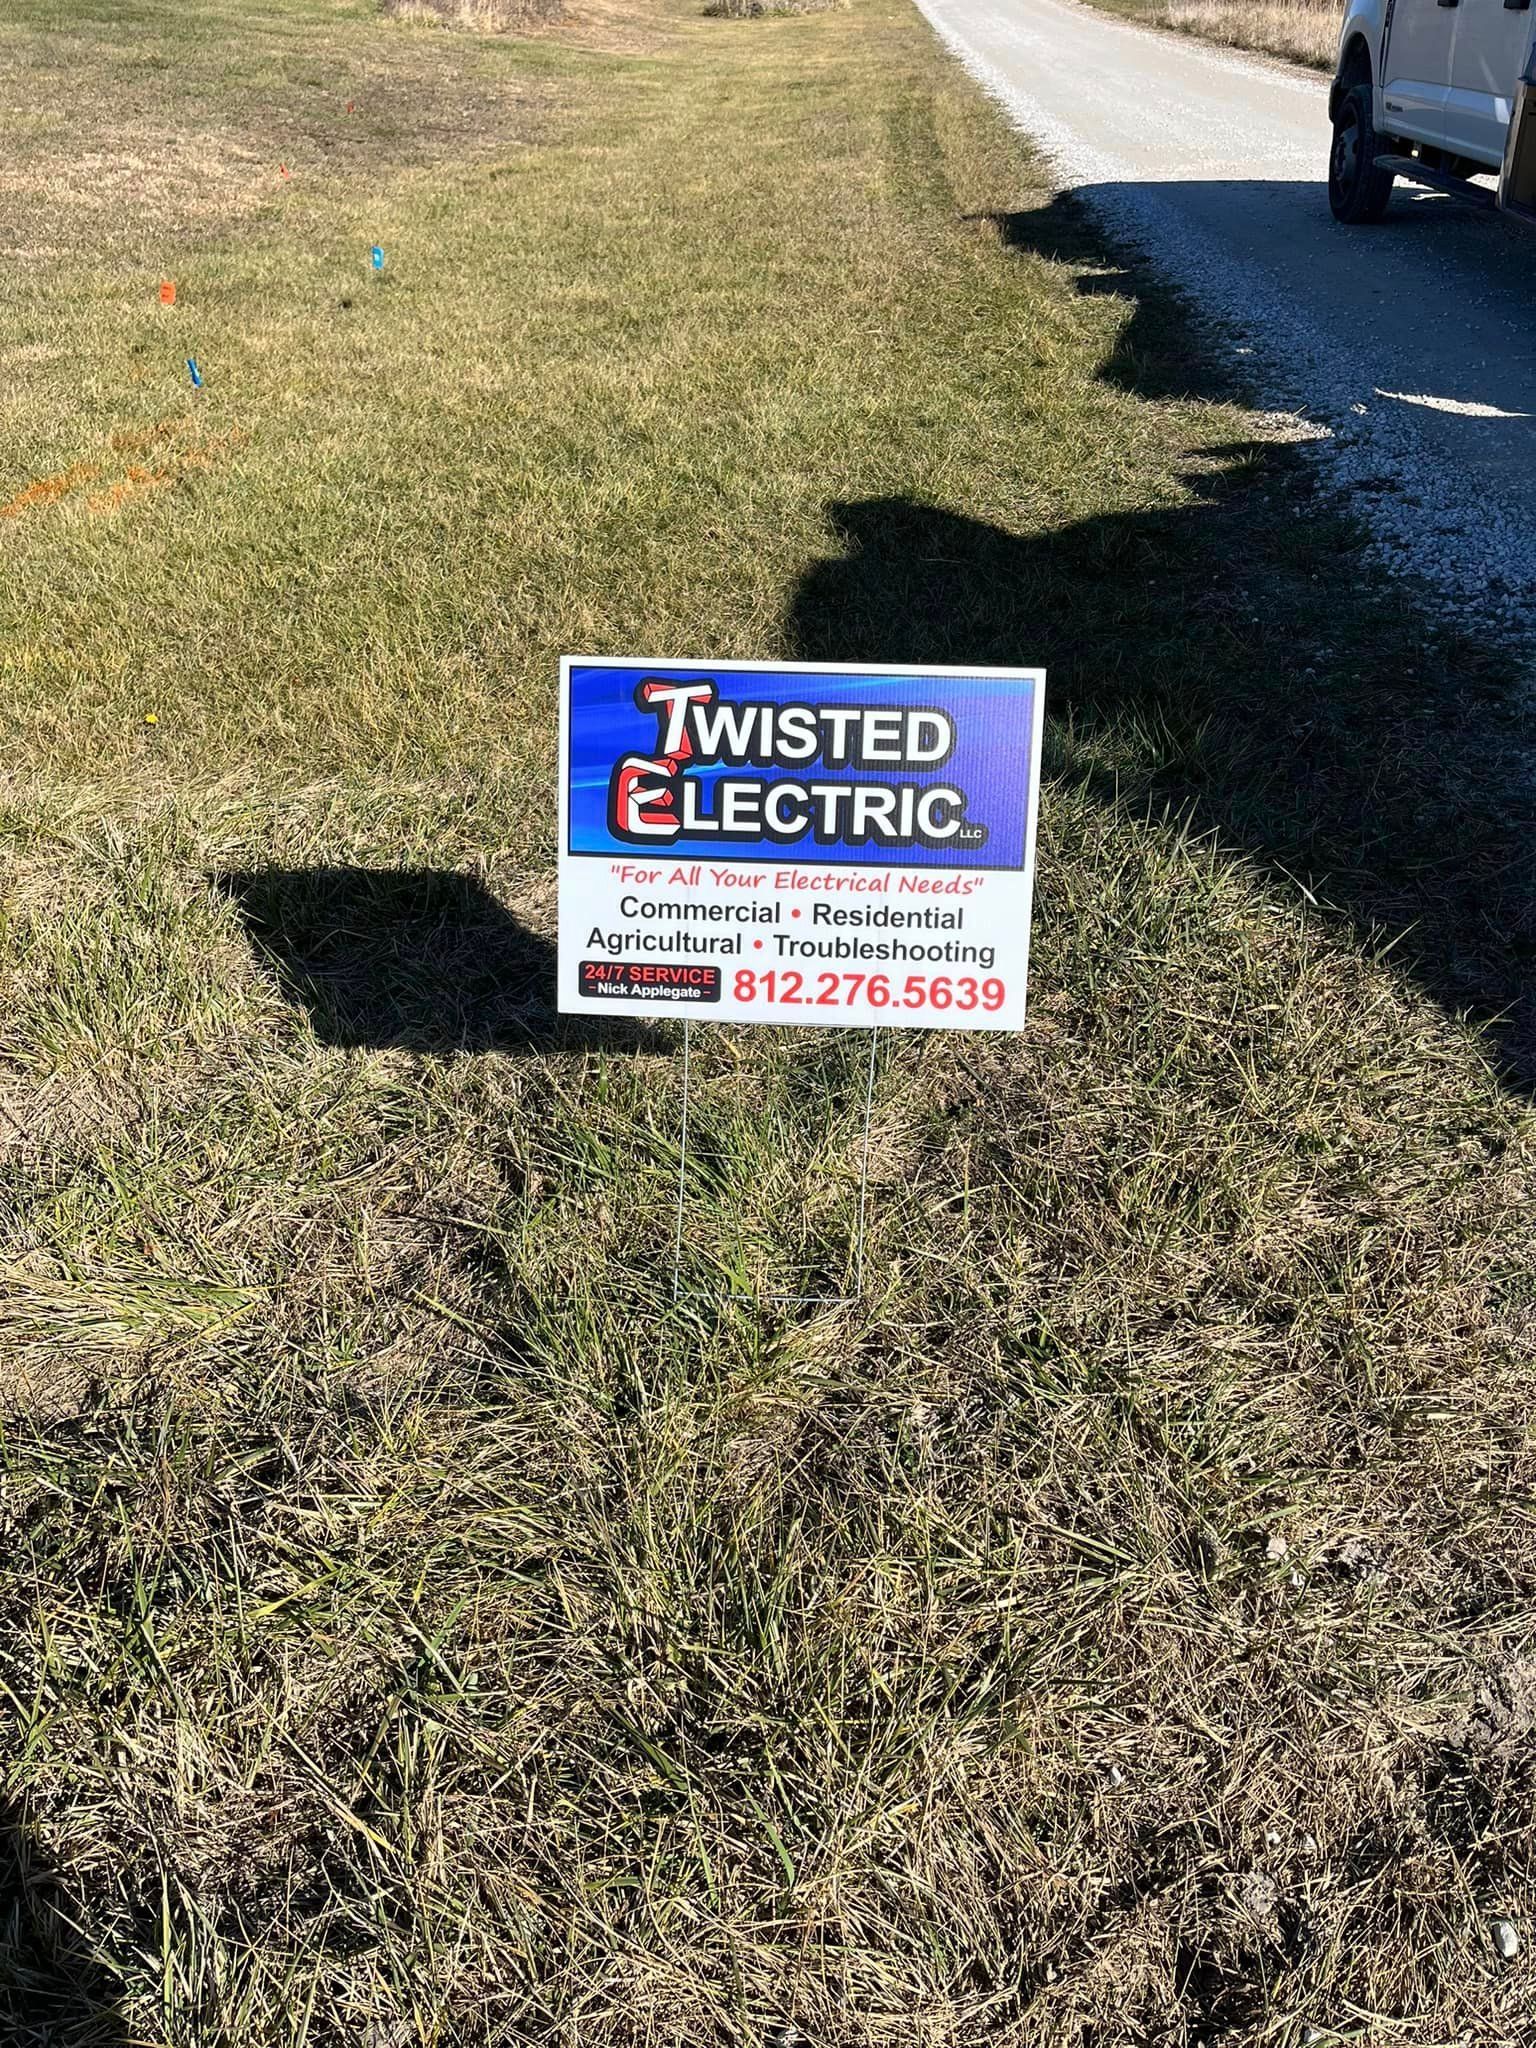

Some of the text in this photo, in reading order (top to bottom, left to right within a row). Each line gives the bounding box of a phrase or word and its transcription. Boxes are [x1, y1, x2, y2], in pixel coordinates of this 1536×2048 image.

[643, 682, 952, 762] TWISTED
[616, 756, 983, 839] ELECTRIC LLC
[611, 865, 984, 895] "For All Your Electrical Needs"
[620, 895, 963, 930] Commercial Residential
[586, 927, 996, 969] Agricultural Troubleshooting
[584, 964, 716, 984] 24/7 SERVICE
[597, 982, 702, 1000] Nick Applegate
[733, 968, 1006, 1012] 812.276.5639
